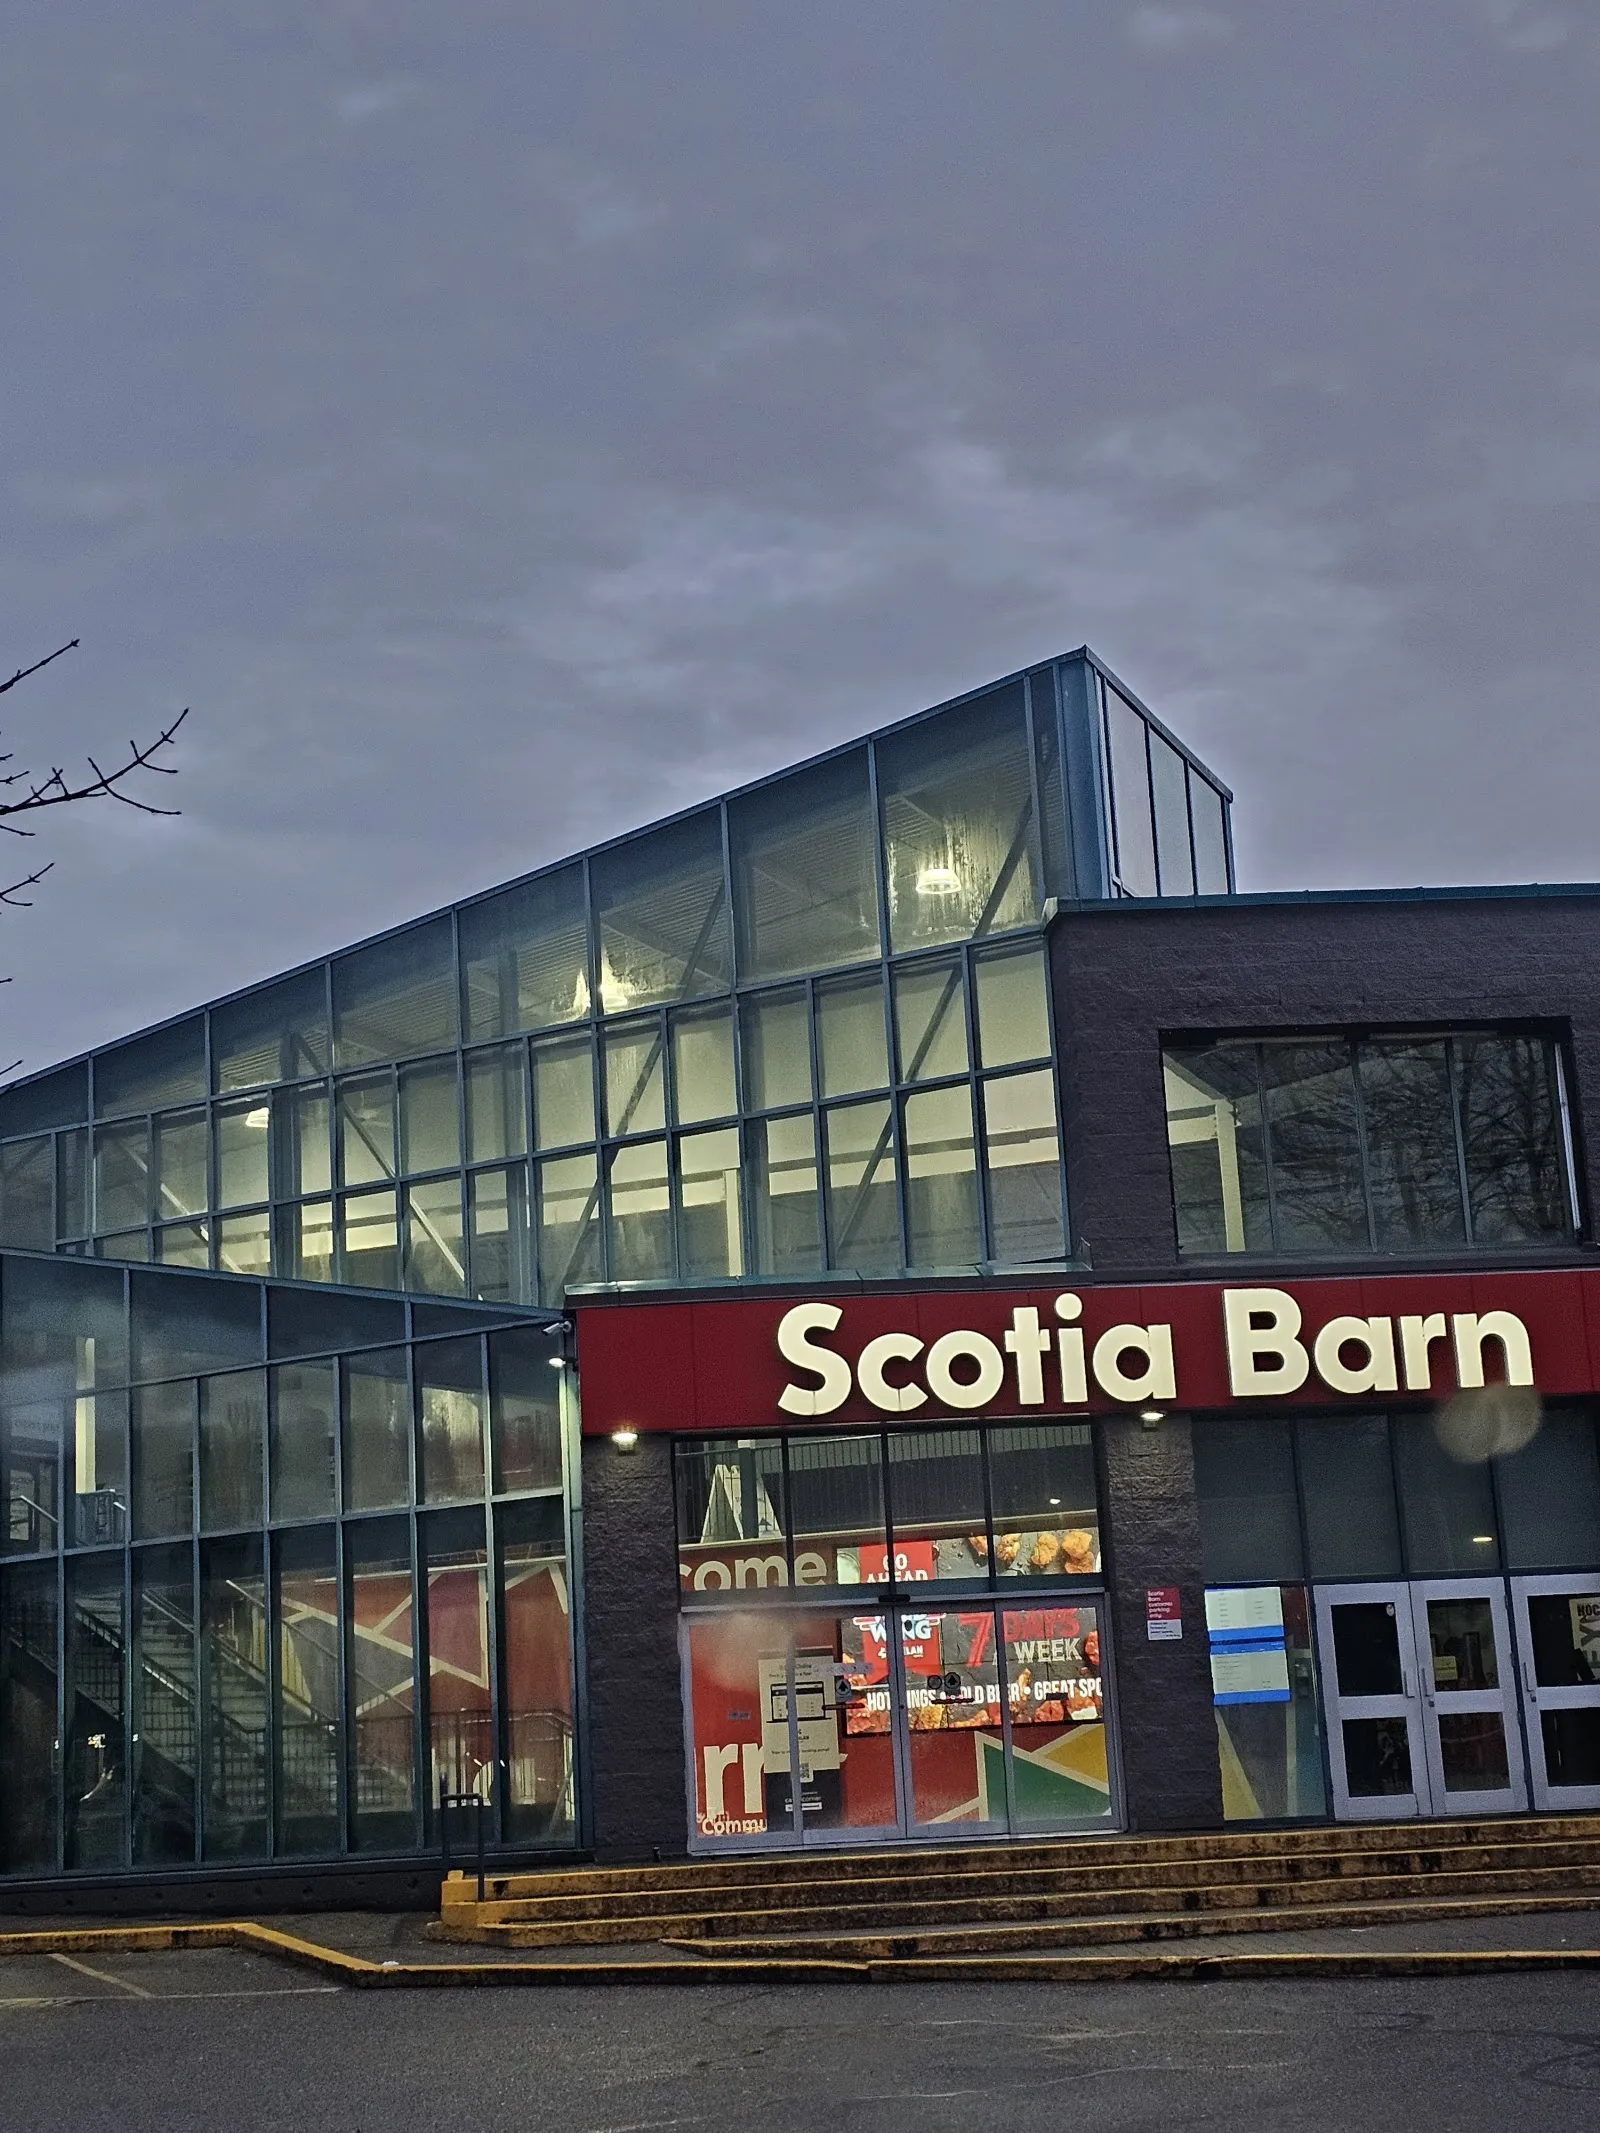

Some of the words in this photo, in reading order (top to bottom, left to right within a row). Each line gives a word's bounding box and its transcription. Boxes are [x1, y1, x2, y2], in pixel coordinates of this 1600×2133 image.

[777, 1292, 1177, 1416] Scotia
[1222, 1287, 1535, 1398] Barn
[870, 1620, 932, 1643] WNG
[958, 1611, 995, 1668] 7
[1002, 1608, 1081, 1641] DAYS
[1013, 1637, 1083, 1664] WEEK
[906, 1688, 937, 1709] INGS
[1034, 1679, 1077, 1701] GREAT
